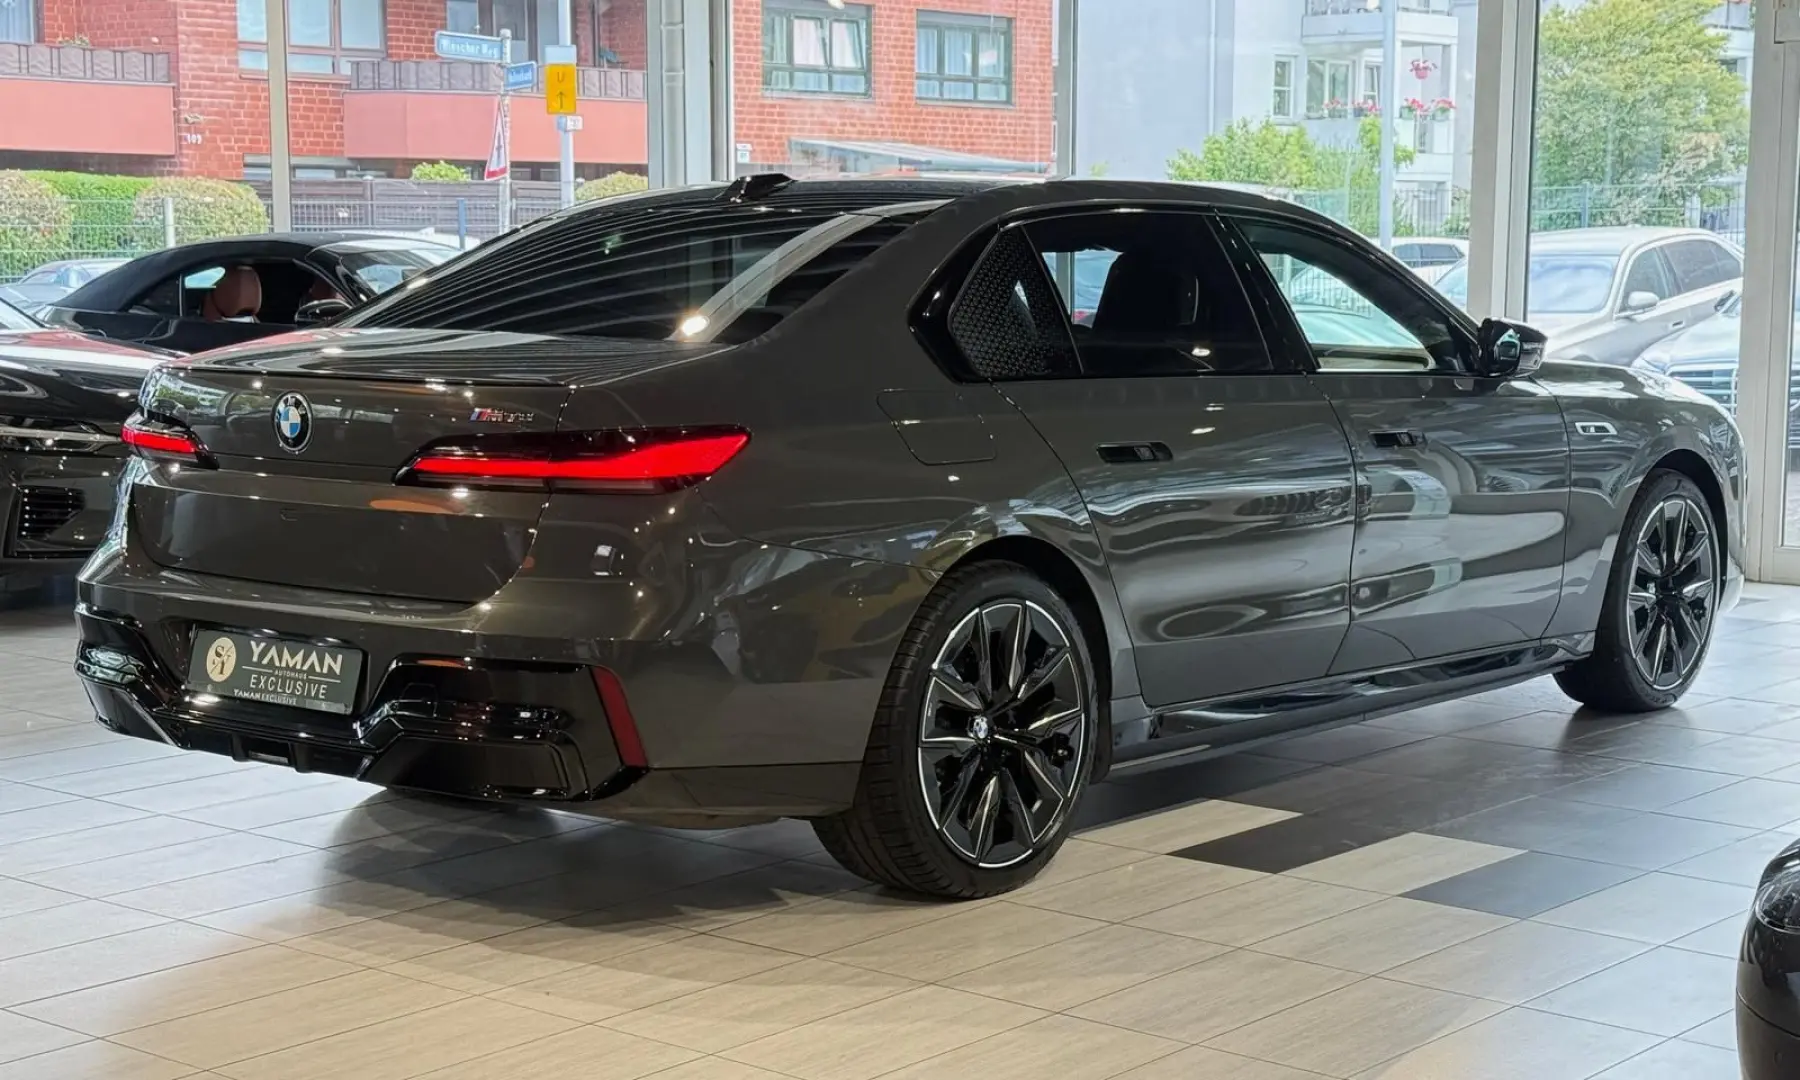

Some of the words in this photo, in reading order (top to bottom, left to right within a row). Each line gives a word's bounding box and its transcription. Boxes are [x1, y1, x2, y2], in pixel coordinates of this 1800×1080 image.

[250, 640, 343, 676] YAMAN
[274, 669, 308, 680] AUTOHAUS
[233, 688, 260, 700] YAMAN
[249, 674, 328, 699] EXCLUSIVE
